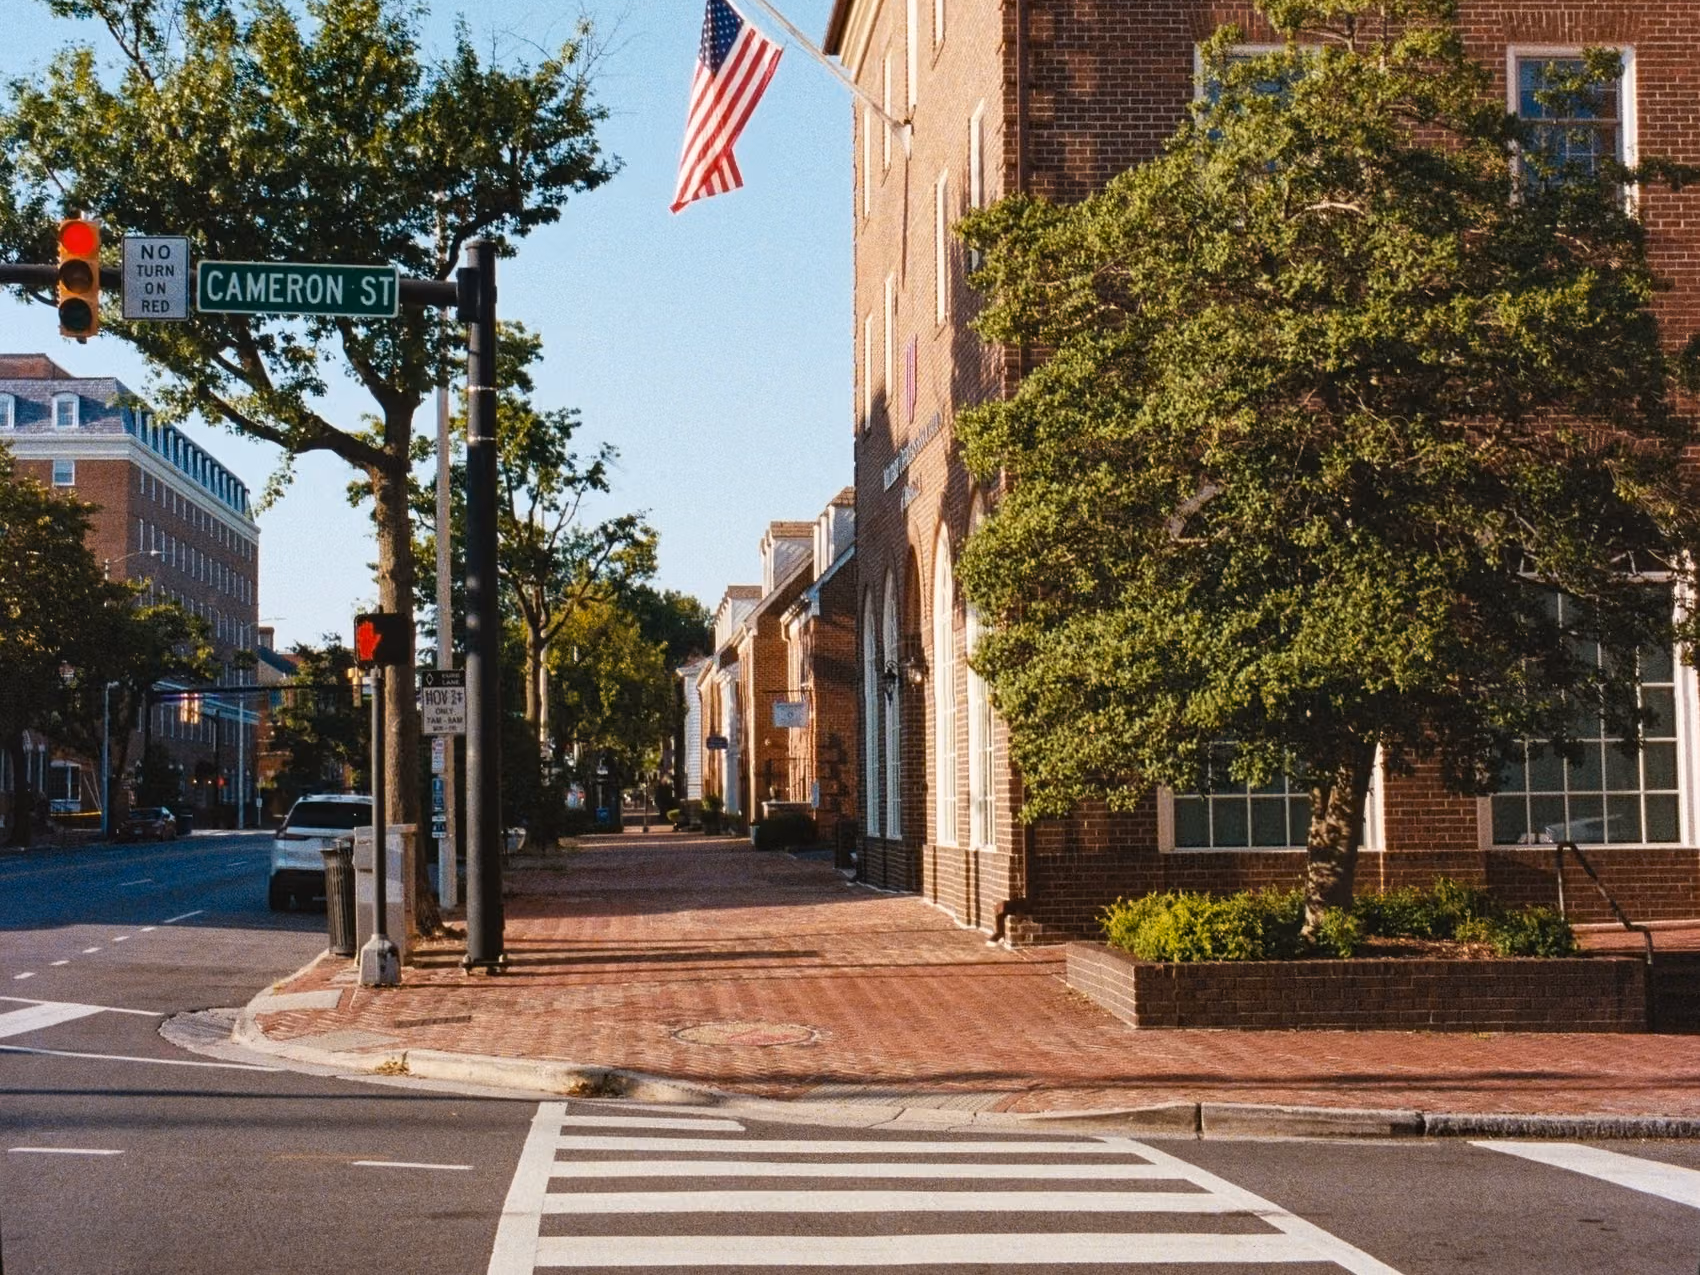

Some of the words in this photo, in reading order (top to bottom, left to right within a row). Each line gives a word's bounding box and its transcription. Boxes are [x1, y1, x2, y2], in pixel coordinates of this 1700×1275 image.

[141, 244, 171, 260] NO
[136, 264, 175, 278] TURN
[145, 282, 166, 295] ON
[206, 270, 344, 305] CAMERON
[360, 276, 394, 306] ST
[141, 300, 170, 313] RED
[425, 689, 448, 706] HOV
[435, 707, 453, 715] ONLY
